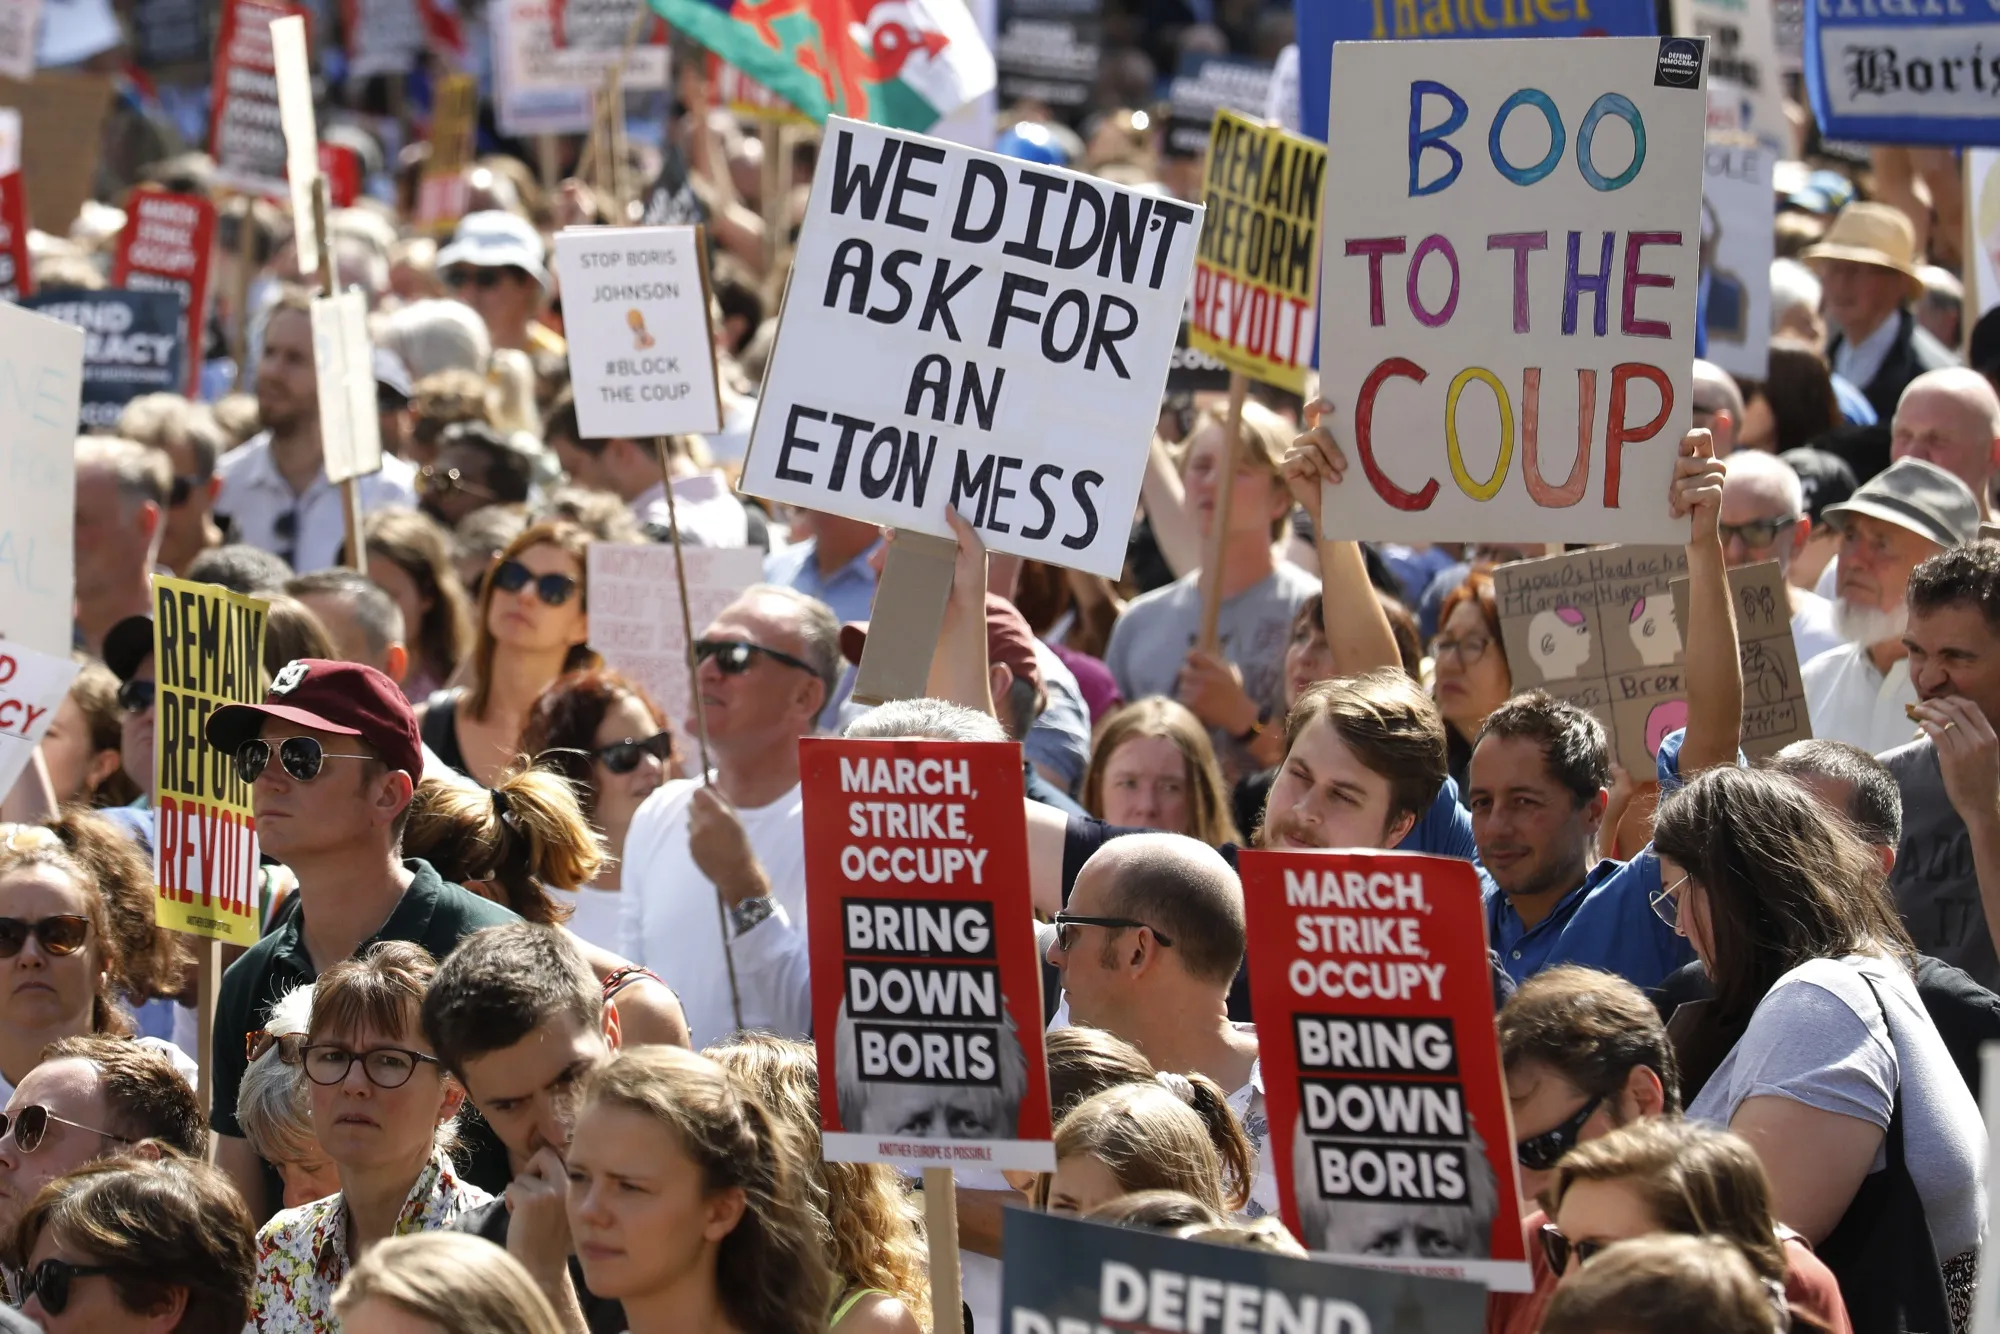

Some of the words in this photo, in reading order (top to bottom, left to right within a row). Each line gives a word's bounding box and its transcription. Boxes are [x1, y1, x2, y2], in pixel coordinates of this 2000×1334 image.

[1660, 57, 1699, 68] DEMOCRACY
[1668, 52, 1692, 61] DEFEND
[1409, 80, 1646, 197] BOO
[1210, 118, 1327, 221] REMAIN
[830, 130, 946, 232] WE
[950, 158, 1194, 289] DIDN'T
[580, 252, 621, 268] STOP
[626, 250, 677, 266] BORIS
[1200, 191, 1314, 295] REFORM
[592, 282, 680, 303] JOHNSON
[822, 238, 983, 343] ASK
[987, 272, 1138, 379] FOR
[1345, 233, 1460, 328] TO
[1487, 230, 1683, 340] THE
[1193, 264, 1309, 370] REVOLT
[599, 385, 635, 403] THE
[640, 382, 691, 401] COUP
[605, 357, 681, 376] #BLOCK
[904, 354, 1006, 431] AN
[1355, 357, 1674, 512] COUP
[774, 404, 938, 508] ETON
[950, 449, 1104, 550] MESS
[158, 586, 261, 704] REMAIN
[1619, 674, 1687, 699] Brex
[161, 691, 249, 807] REFO
[839, 757, 978, 800] MARCH,
[848, 801, 974, 844] STRIKE,
[159, 796, 256, 918] REVOLT
[840, 845, 988, 884] OCCUPY
[1283, 868, 1433, 915] MARCH,
[847, 904, 990, 953] BRING
[1296, 915, 1430, 960] STRIKE,
[849, 967, 996, 1016] DOWN
[1288, 959, 1446, 1000] OCCUPY
[860, 1030, 996, 1080] BORIS
[1297, 1018, 1452, 1070] BRING
[1303, 1083, 1464, 1135] DOWN
[1318, 1147, 1466, 1200] BORIS
[1101, 1261, 1372, 1334] DEFEND
